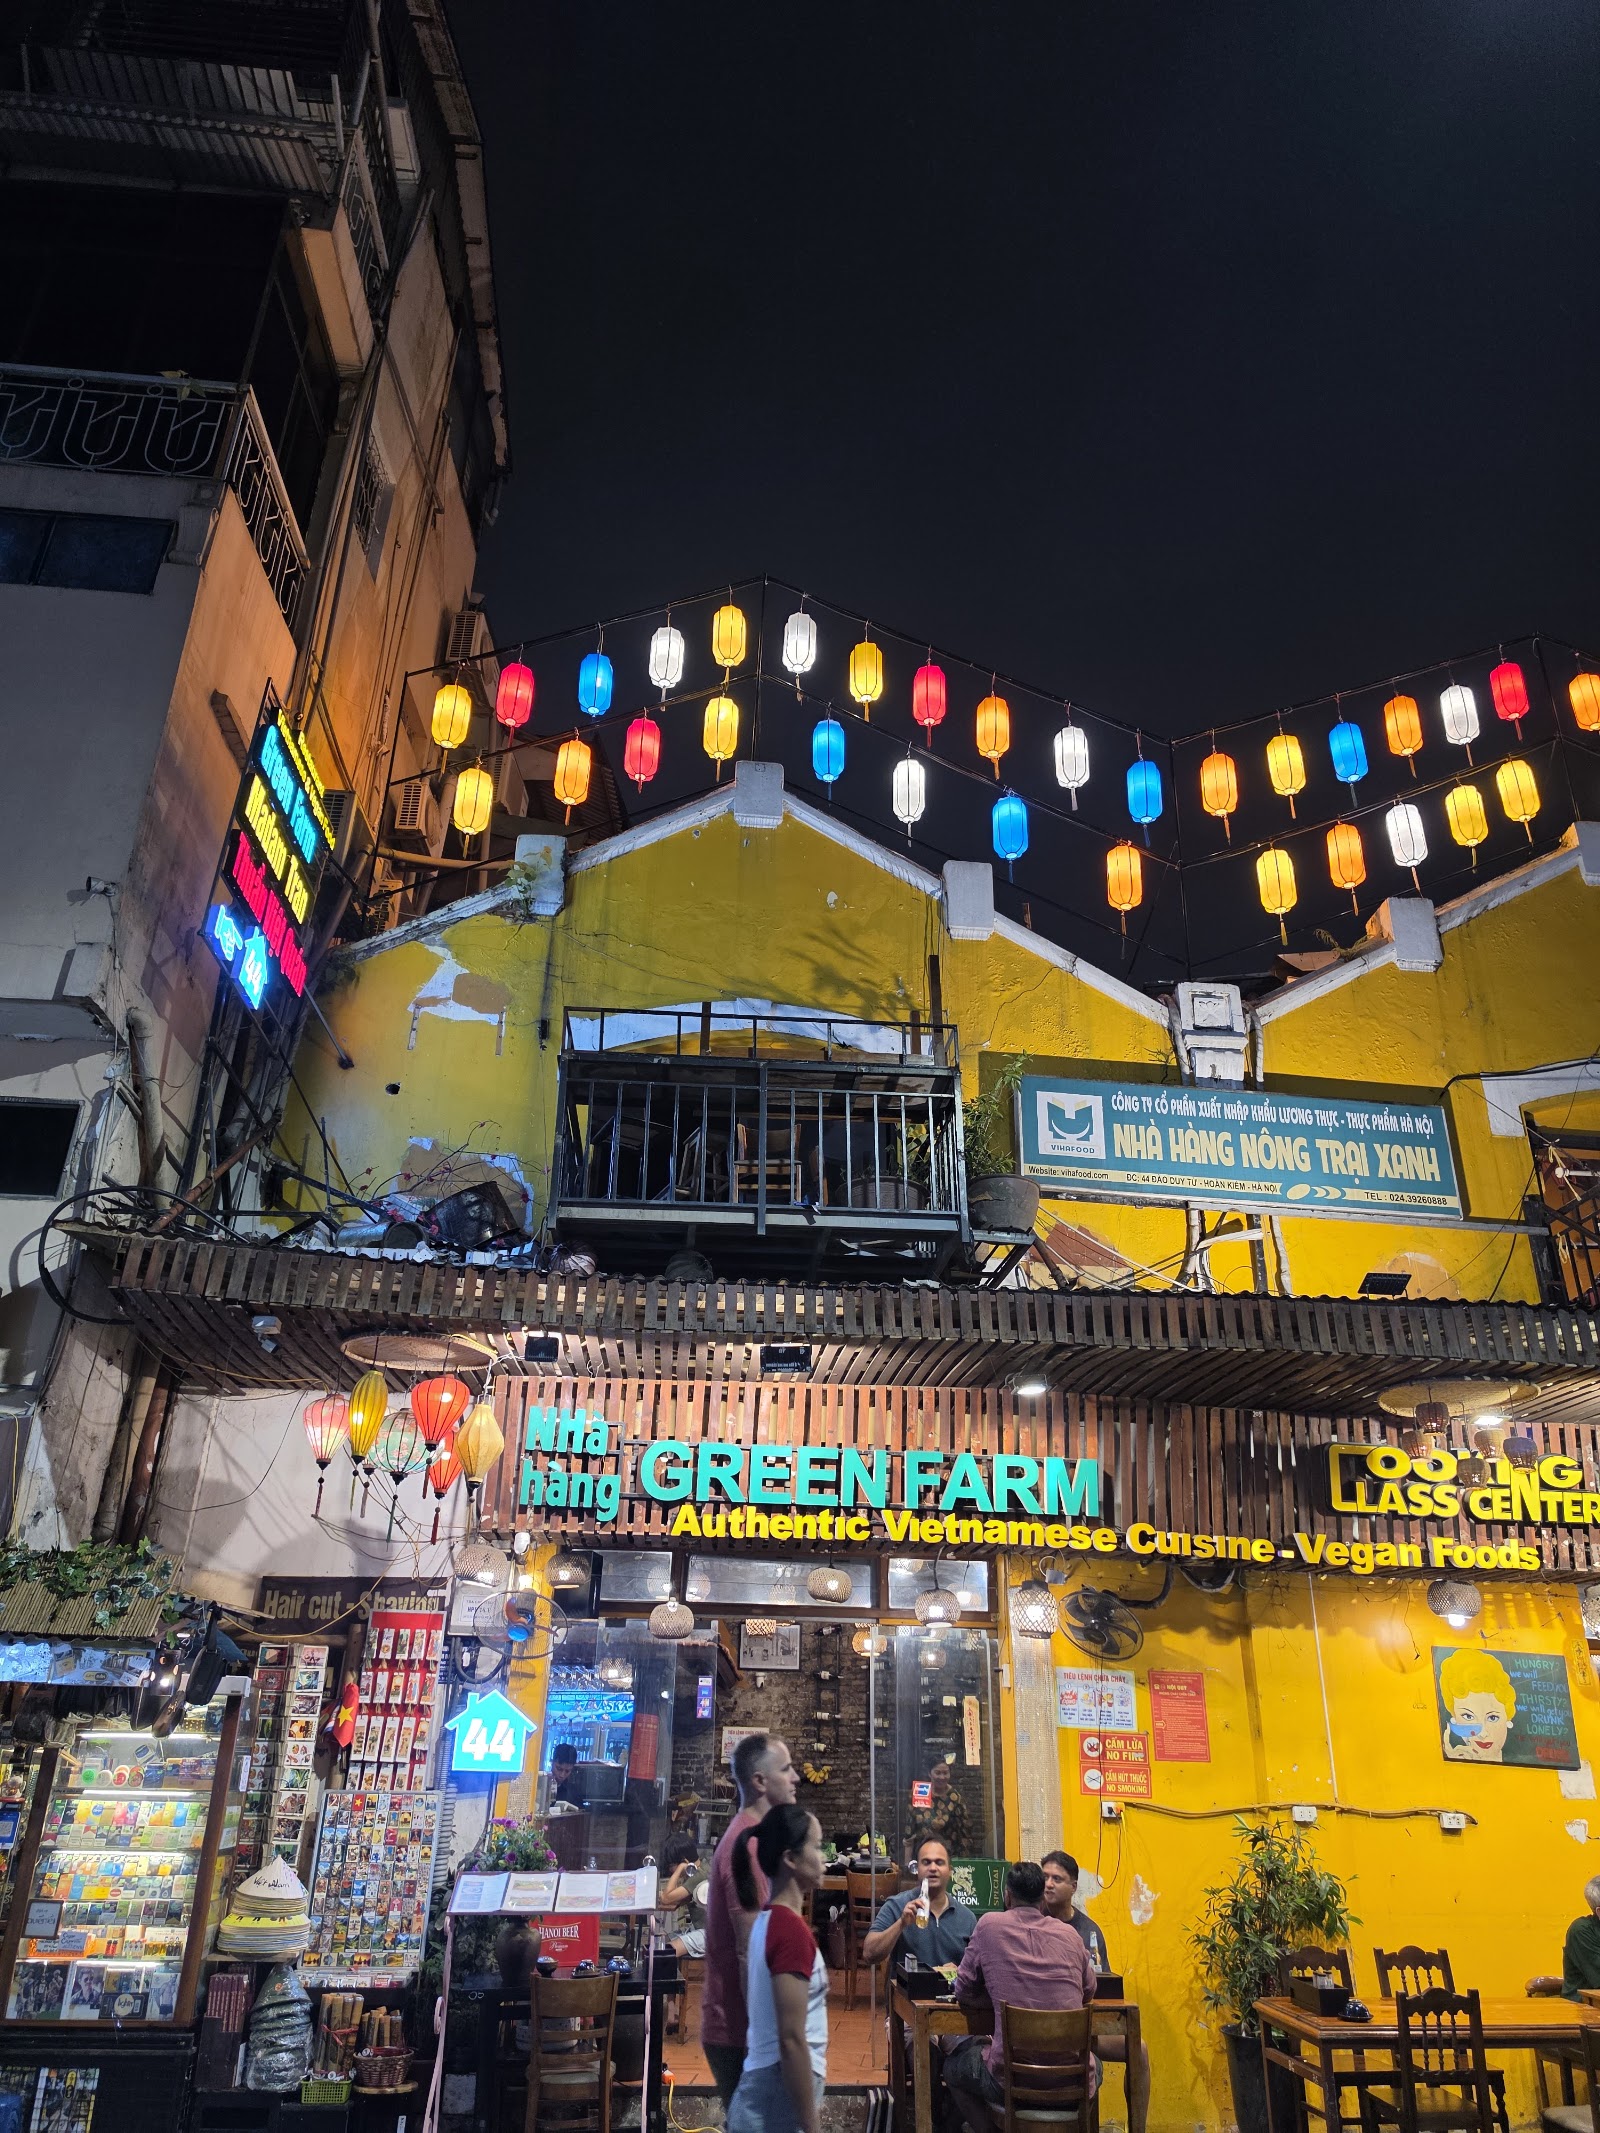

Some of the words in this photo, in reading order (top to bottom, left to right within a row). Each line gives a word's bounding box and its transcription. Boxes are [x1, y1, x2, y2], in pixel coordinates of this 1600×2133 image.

[261, 724, 294, 815] Green
[289, 786, 316, 864] Farm
[245, 775, 287, 881] Madam
[284, 855, 308, 924] Tran
[280, 927, 307, 998] Quán
[246, 949, 262, 995] 44
[1111, 1091, 1140, 1112] CÔNG
[1141, 1096, 1152, 1112] TY
[1155, 1090, 1168, 1115] CỔ
[1170, 1093, 1197, 1117] PHẦN
[1198, 1096, 1222, 1119] XUẤT
[1223, 1101, 1250, 1126] NHẬP
[1251, 1098, 1277, 1123] KHẨU
[1279, 1106, 1313, 1125] LƯƠNG
[1314, 1110, 1340, 1132] THỰC
[1346, 1112, 1371, 1135] THỰC
[1372, 1107, 1400, 1132] PHẨM
[1400, 1113, 1415, 1133] HÀ
[1416, 1115, 1435, 1139] NỘI
[1050, 1144, 1095, 1154] VIHAFOOD
[1113, 1118, 1164, 1161] NHÀ
[1168, 1121, 1236, 1167] HÀNG
[1239, 1126, 1312, 1173] NÔNG
[1315, 1138, 1371, 1185] TRẠI
[1374, 1143, 1442, 1182] XANH
[1028, 1165, 1060, 1177] Website:
[1060, 1168, 1109, 1180] vihafood.com
[1126, 1172, 1140, 1183] ĐC:
[1141, 1174, 1150, 1184] 44
[1169, 1176, 1185, 1187] DUY
[1203, 1177, 1226, 1190] HOÀN
[1251, 1181, 1263, 1192] HÀ
[1364, 1191, 1382, 1201] TEL
[1389, 1193, 1448, 1206] 024.39260888
[638, 1441, 887, 1508] GREEN
[903, 1449, 1100, 1518] FARM
[520, 1459, 621, 1521] hàng
[670, 1503, 872, 1542] Authentic
[883, 1508, 1118, 1553] Vietnamese
[1126, 1522, 1275, 1562] Cuisine
[1293, 1532, 1422, 1575] Vegan
[1427, 1536, 1541, 1571] Foods
[264, 1589, 305, 1620] Hair
[308, 1591, 341, 1620] cut
[1523, 1670, 1538, 1679] will
[1531, 1680, 1553, 1692] FEED
[1520, 1693, 1567, 1708] THIRSTY?
[1516, 1704, 1528, 1712] we
[1530, 1704, 1545, 1714] will
[1531, 1713, 1564, 1725] DRUNK
[1526, 1723, 1569, 1736] LONELY?
[461, 1718, 516, 1762] 44
[1106, 1750, 1120, 1761] NO
[1106, 1783, 1116, 1792] NO
[1117, 1784, 1147, 1794] SMOKING
[952, 1896, 980, 1905] IGON.
[539, 1926, 560, 1939] HANOI
[562, 1925, 579, 1938] BEER
